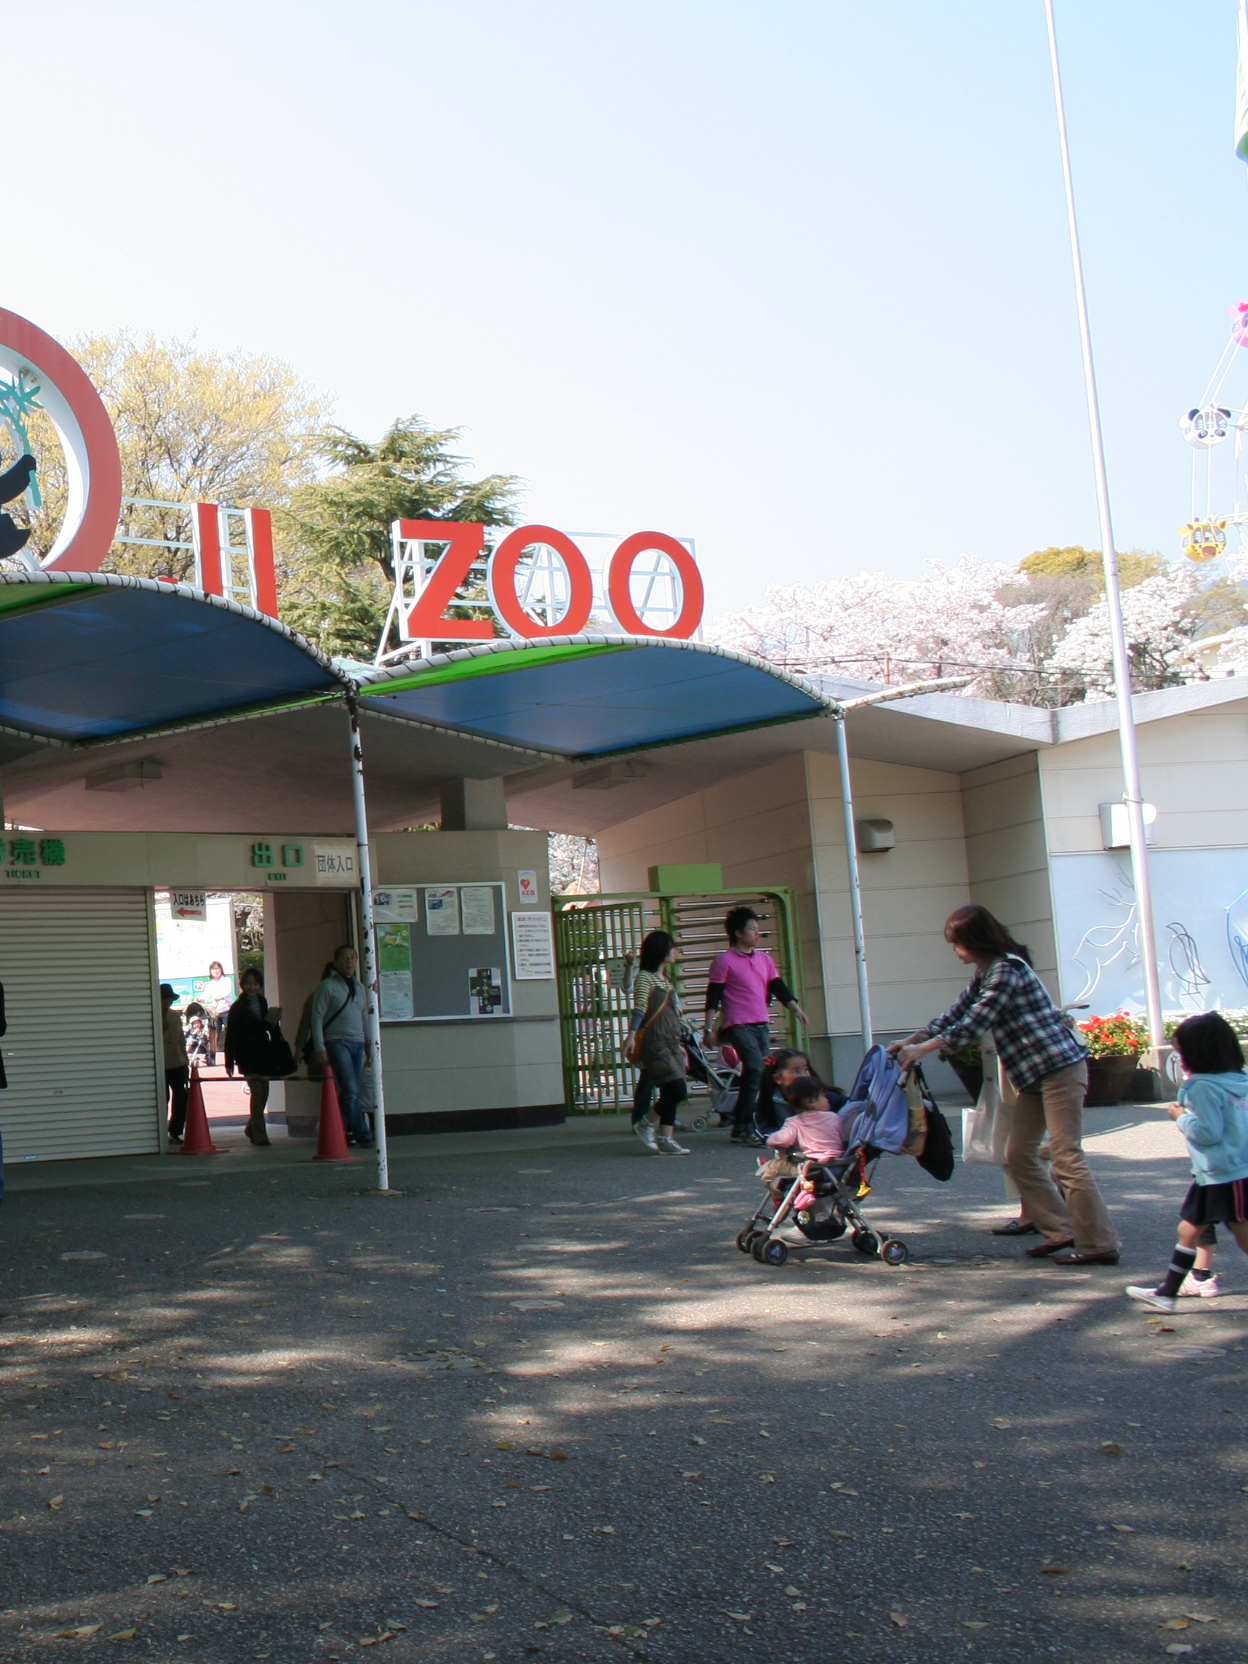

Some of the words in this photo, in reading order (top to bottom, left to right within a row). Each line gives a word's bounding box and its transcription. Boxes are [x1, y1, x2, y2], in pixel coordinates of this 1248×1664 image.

[392, 519, 704, 641] ZOO
[253, 842, 305, 868] 出口
[317, 854, 353, 874] 団体入口
[5, 869, 42, 880] TICKET
[268, 872, 289, 881] EXIT
